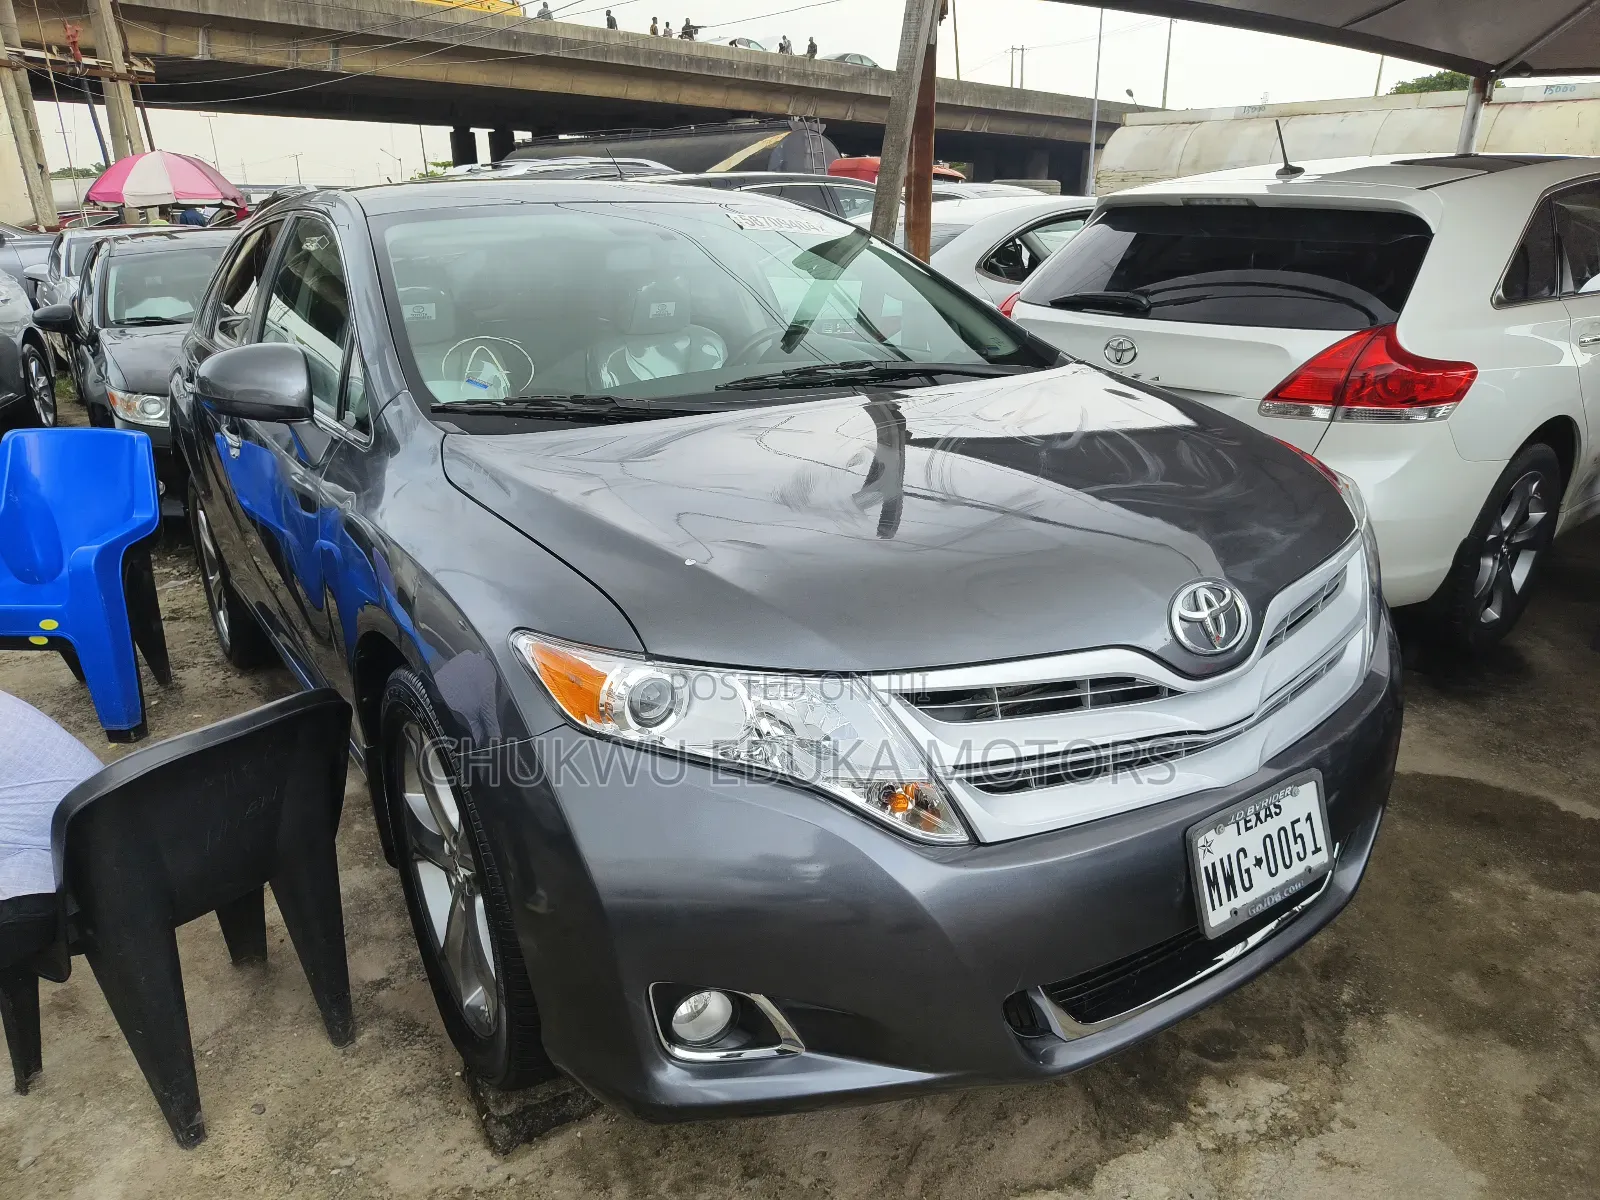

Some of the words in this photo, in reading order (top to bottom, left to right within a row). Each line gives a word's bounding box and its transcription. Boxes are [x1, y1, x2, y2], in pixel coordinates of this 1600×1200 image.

[1544, 85, 1577, 95] 15000
[1235, 800, 1283, 836] TEXAS
[1203, 846, 1254, 912] MWG
[1261, 811, 1323, 879] 0051
